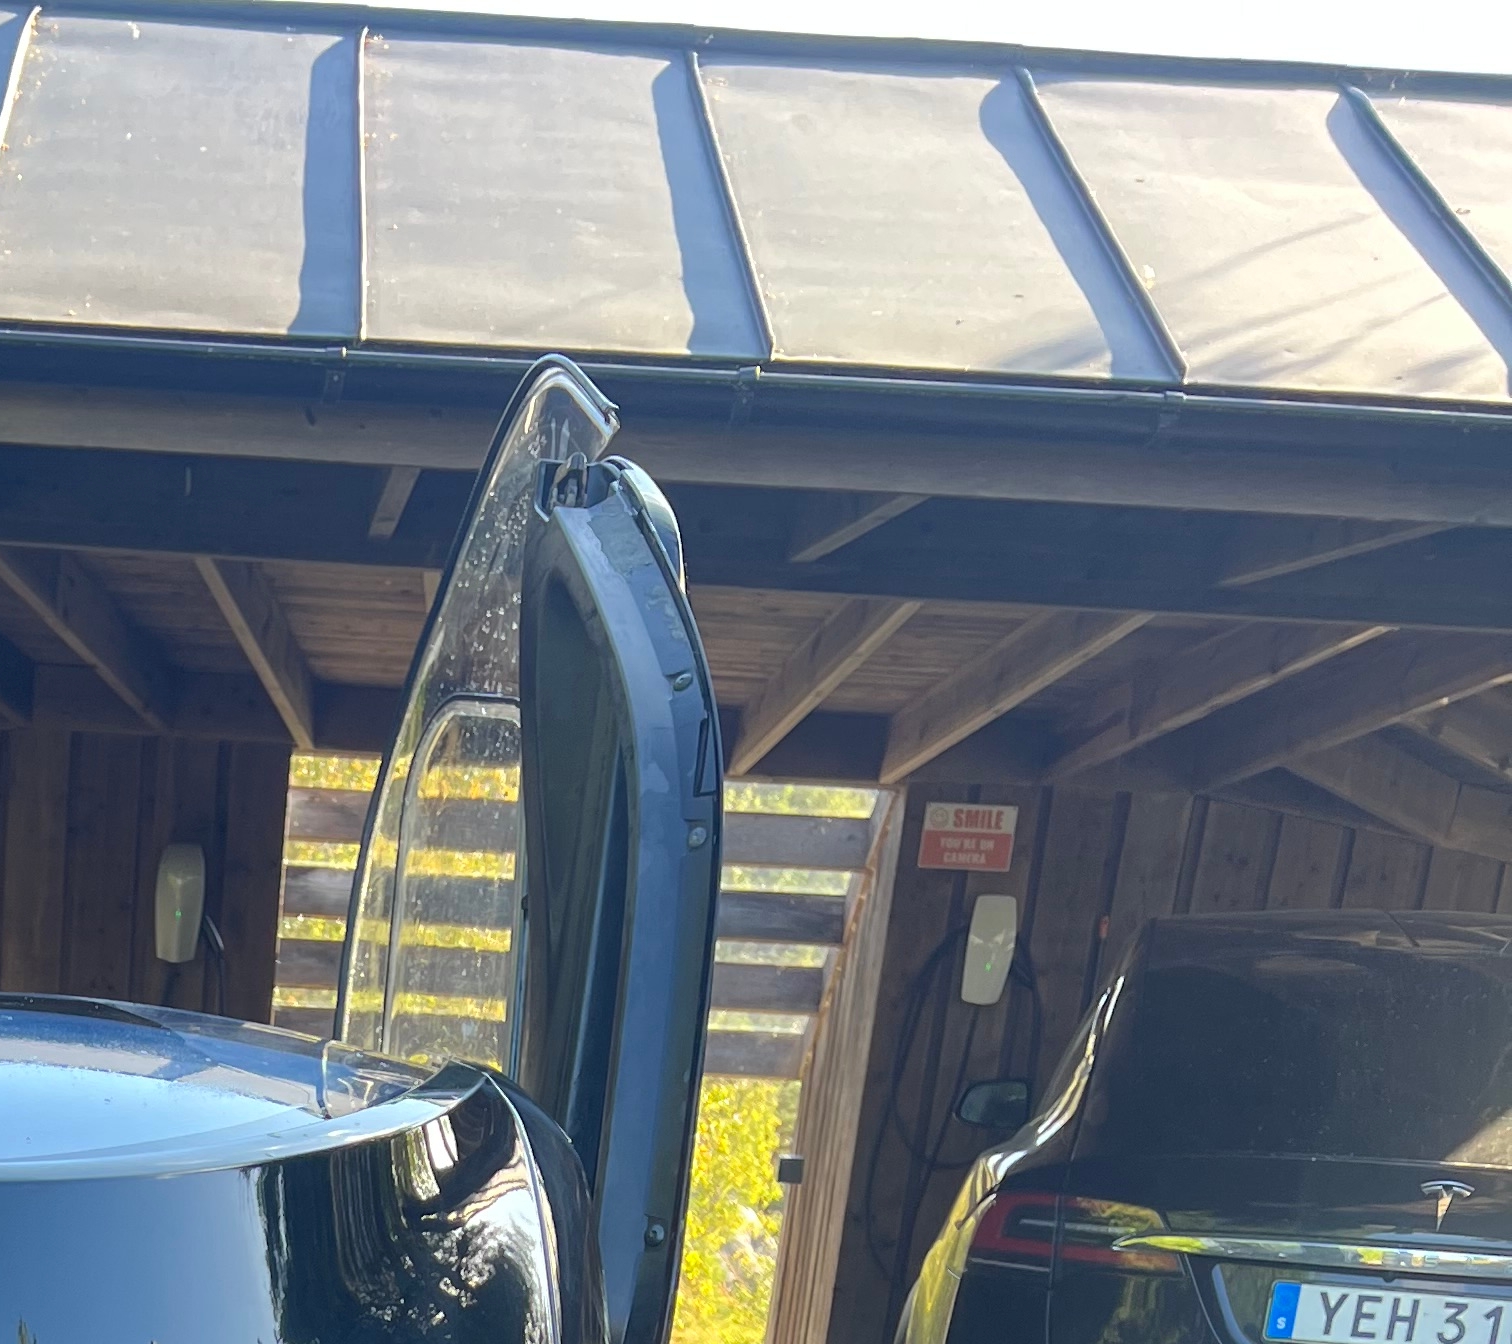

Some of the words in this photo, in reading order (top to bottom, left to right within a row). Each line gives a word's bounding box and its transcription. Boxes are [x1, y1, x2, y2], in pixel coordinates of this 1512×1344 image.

[953, 808, 1004, 830] SMILE
[979, 838, 995, 850] ON
[943, 852, 986, 864] CAMERA
[1320, 1291, 1421, 1342] YEH
[1276, 1317, 1286, 1329] S
